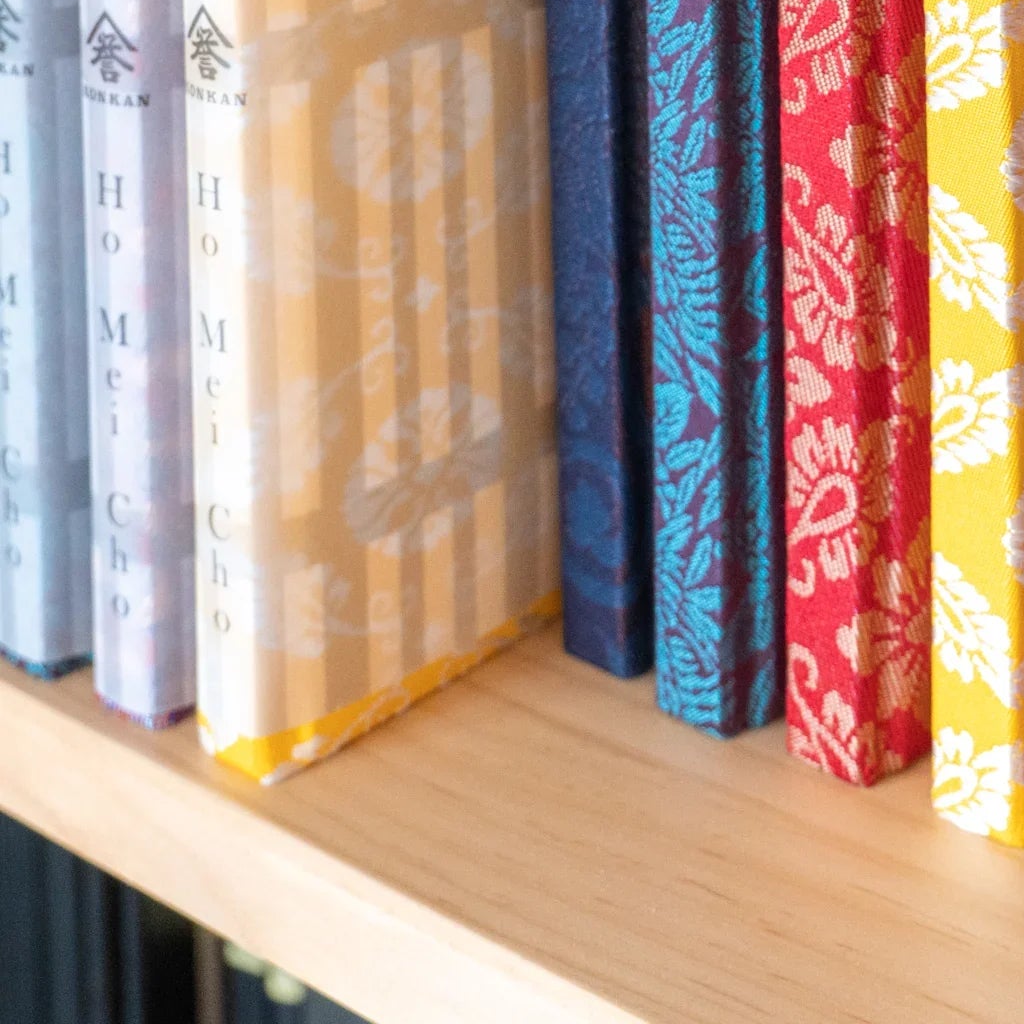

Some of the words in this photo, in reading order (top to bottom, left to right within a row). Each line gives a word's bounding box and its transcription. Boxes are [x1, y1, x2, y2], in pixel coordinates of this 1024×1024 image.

[186, 83, 248, 107] ONKAN
[98, 171, 123, 255] Ho
[198, 171, 222, 257] Ho
[100, 307, 128, 437] Mei
[200, 312, 228, 446] Mei
[1, 446, 22, 568] Cho
[107, 492, 131, 620] Cho
[208, 504, 231, 633] Cho
